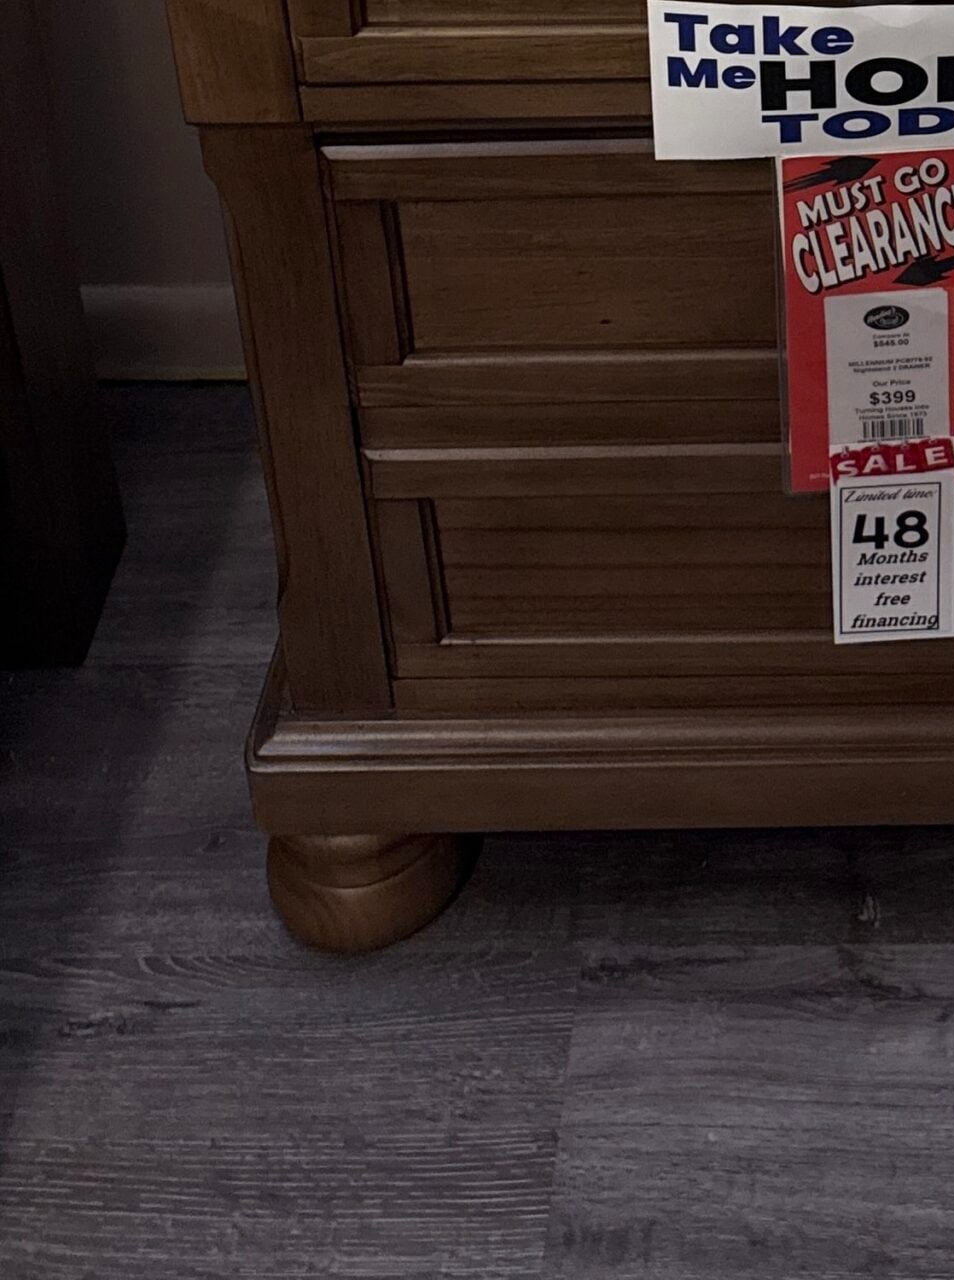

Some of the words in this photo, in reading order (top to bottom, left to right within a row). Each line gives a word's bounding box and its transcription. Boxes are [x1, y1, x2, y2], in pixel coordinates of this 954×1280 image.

[664, 12, 855, 56] Take
[667, 56, 757, 89] Me
[796, 175, 883, 228] MUST
[894, 158, 946, 193] GO
[890, 378, 911, 386] Price
[869, 389, 916, 406] $399
[855, 406, 884, 415] Turning
[885, 404, 913, 413] Houses
[836, 446, 949, 477] SALE
[844, 487, 900, 503] Limited
[852, 510, 929, 549] 48
[856, 550, 928, 566] Months
[854, 570, 927, 587] interest
[874, 592, 911, 607] free
[851, 612, 939, 630] financing
